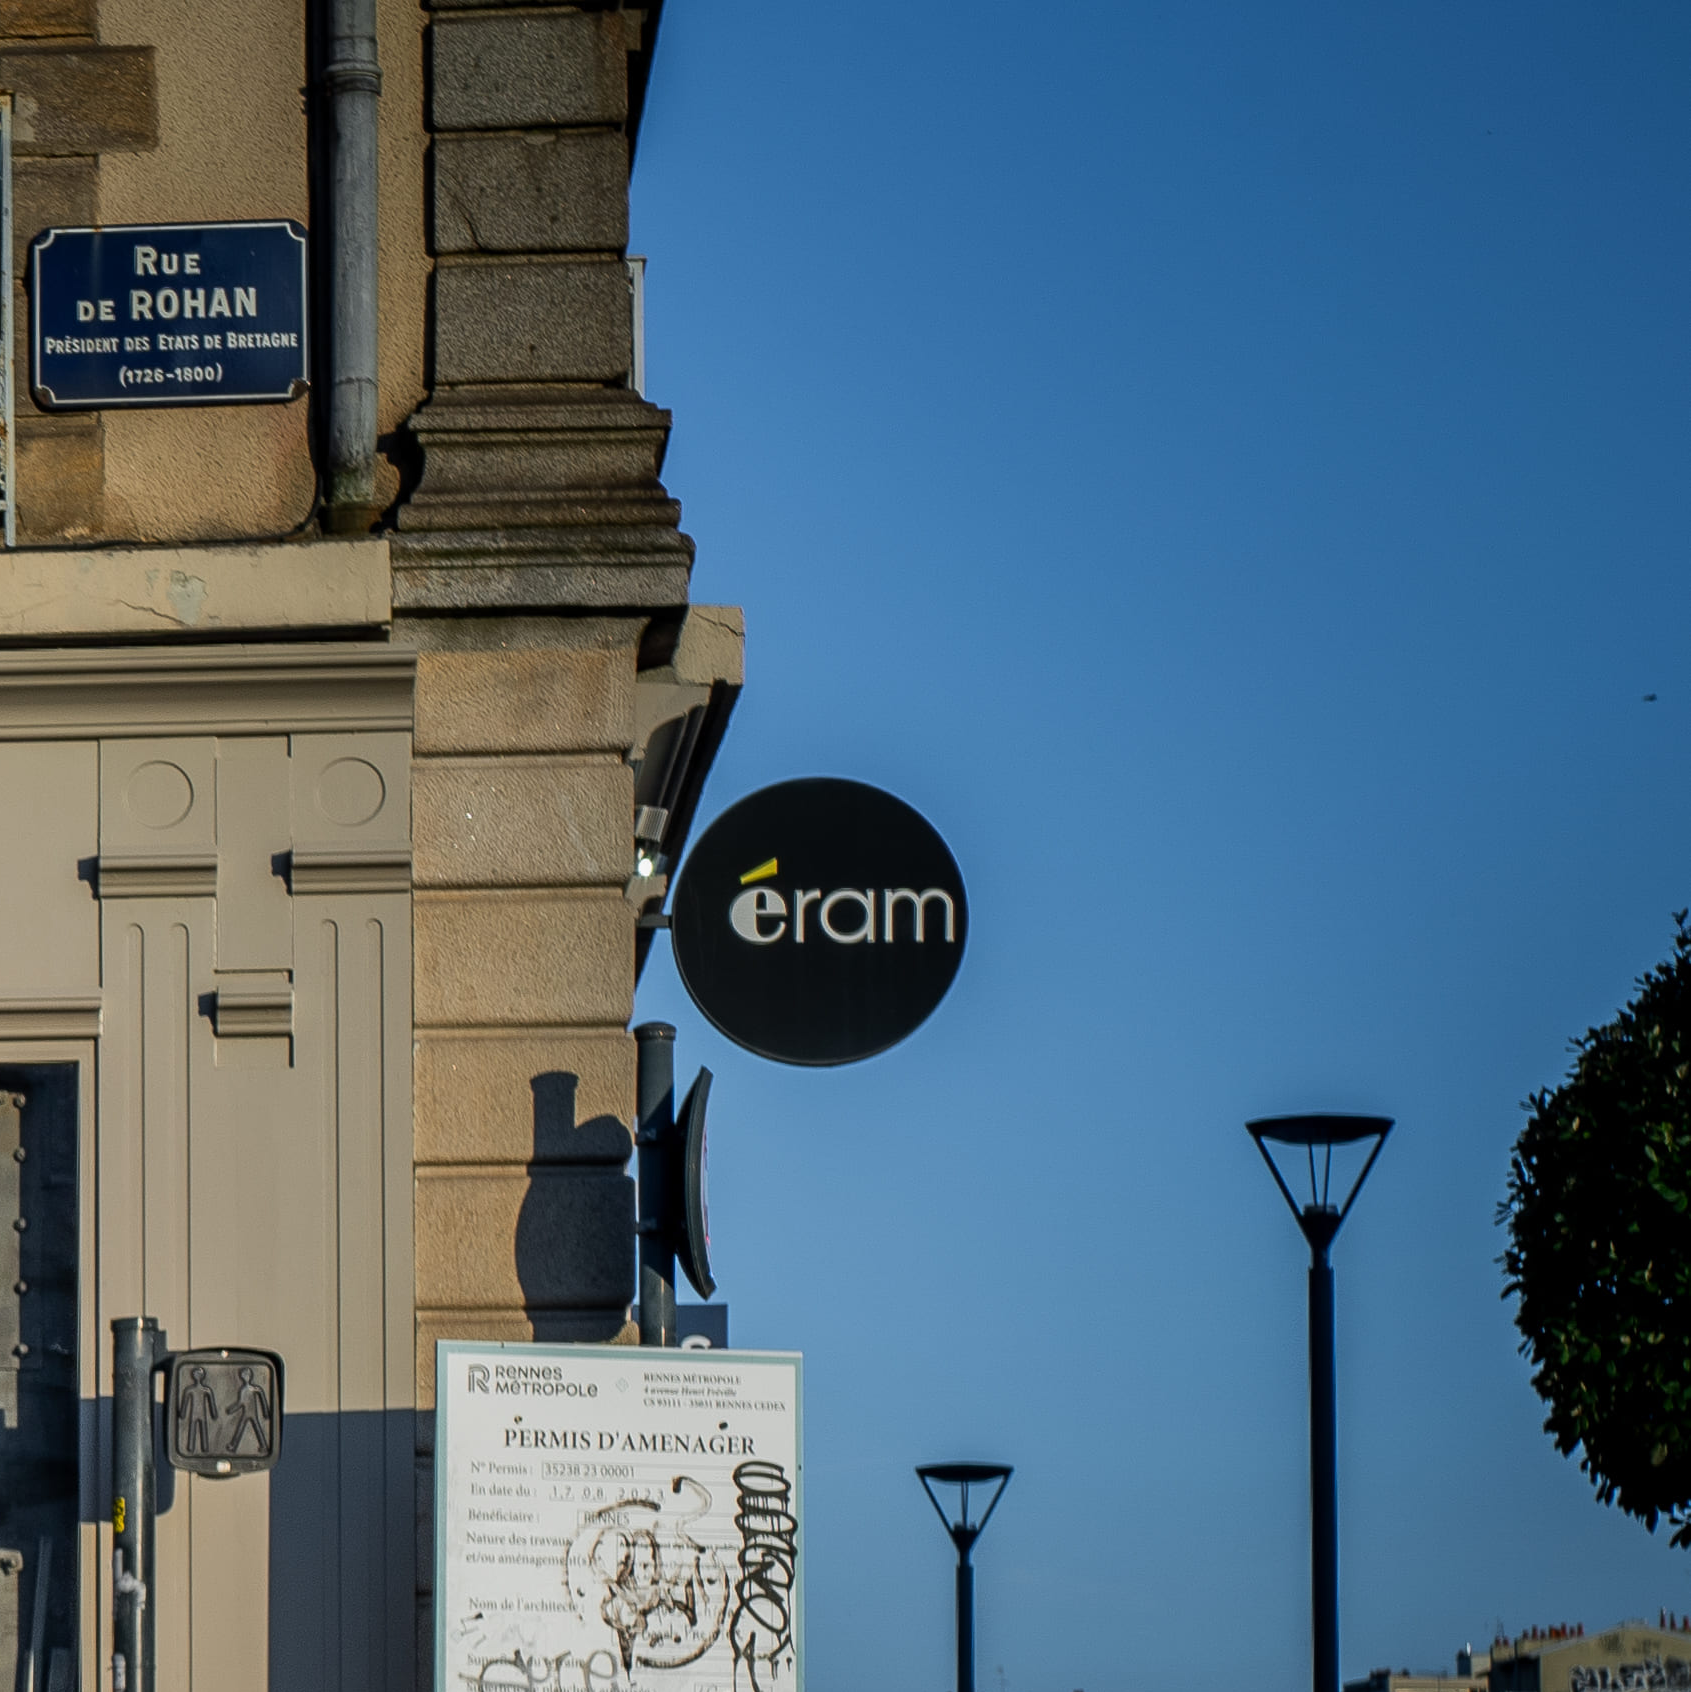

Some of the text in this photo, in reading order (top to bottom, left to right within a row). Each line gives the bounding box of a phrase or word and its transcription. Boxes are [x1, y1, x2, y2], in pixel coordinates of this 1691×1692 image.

[134, 245, 200, 276] RUE
[76, 287, 257, 322] DE ROHAN
[124, 335, 150, 351] DES
[158, 333, 199, 350] ETATS
[204, 332, 222, 350] DE
[227, 331, 298, 349] BRETAGNE
[119, 364, 223, 389] (1726-1800)
[729, 857, 956, 944] éram
[715, 1399, 752, 1410] RENNES
[754, 1400, 786, 1411] CEDEX
[505, 1428, 756, 1456] PERMIS D'AMENAGER
[489, 1463, 528, 1475] Permis
[545, 1463, 581, 1476] 35238
[584, 1464, 597, 1476] 23
[601, 1465, 634, 1477] 00001
[470, 1484, 486, 1496] En
[489, 1484, 513, 1497] date
[516, 1485, 531, 1497] du
[468, 1507, 534, 1522] Bénéficiaire
[467, 1533, 505, 1546] Nature
[509, 1534, 527, 1546] des
[466, 1552, 495, 1564] et/ou
[469, 1598, 497, 1610] Nom
[501, 1598, 513, 1610] de
[518, 1598, 578, 1611] l'architecte
